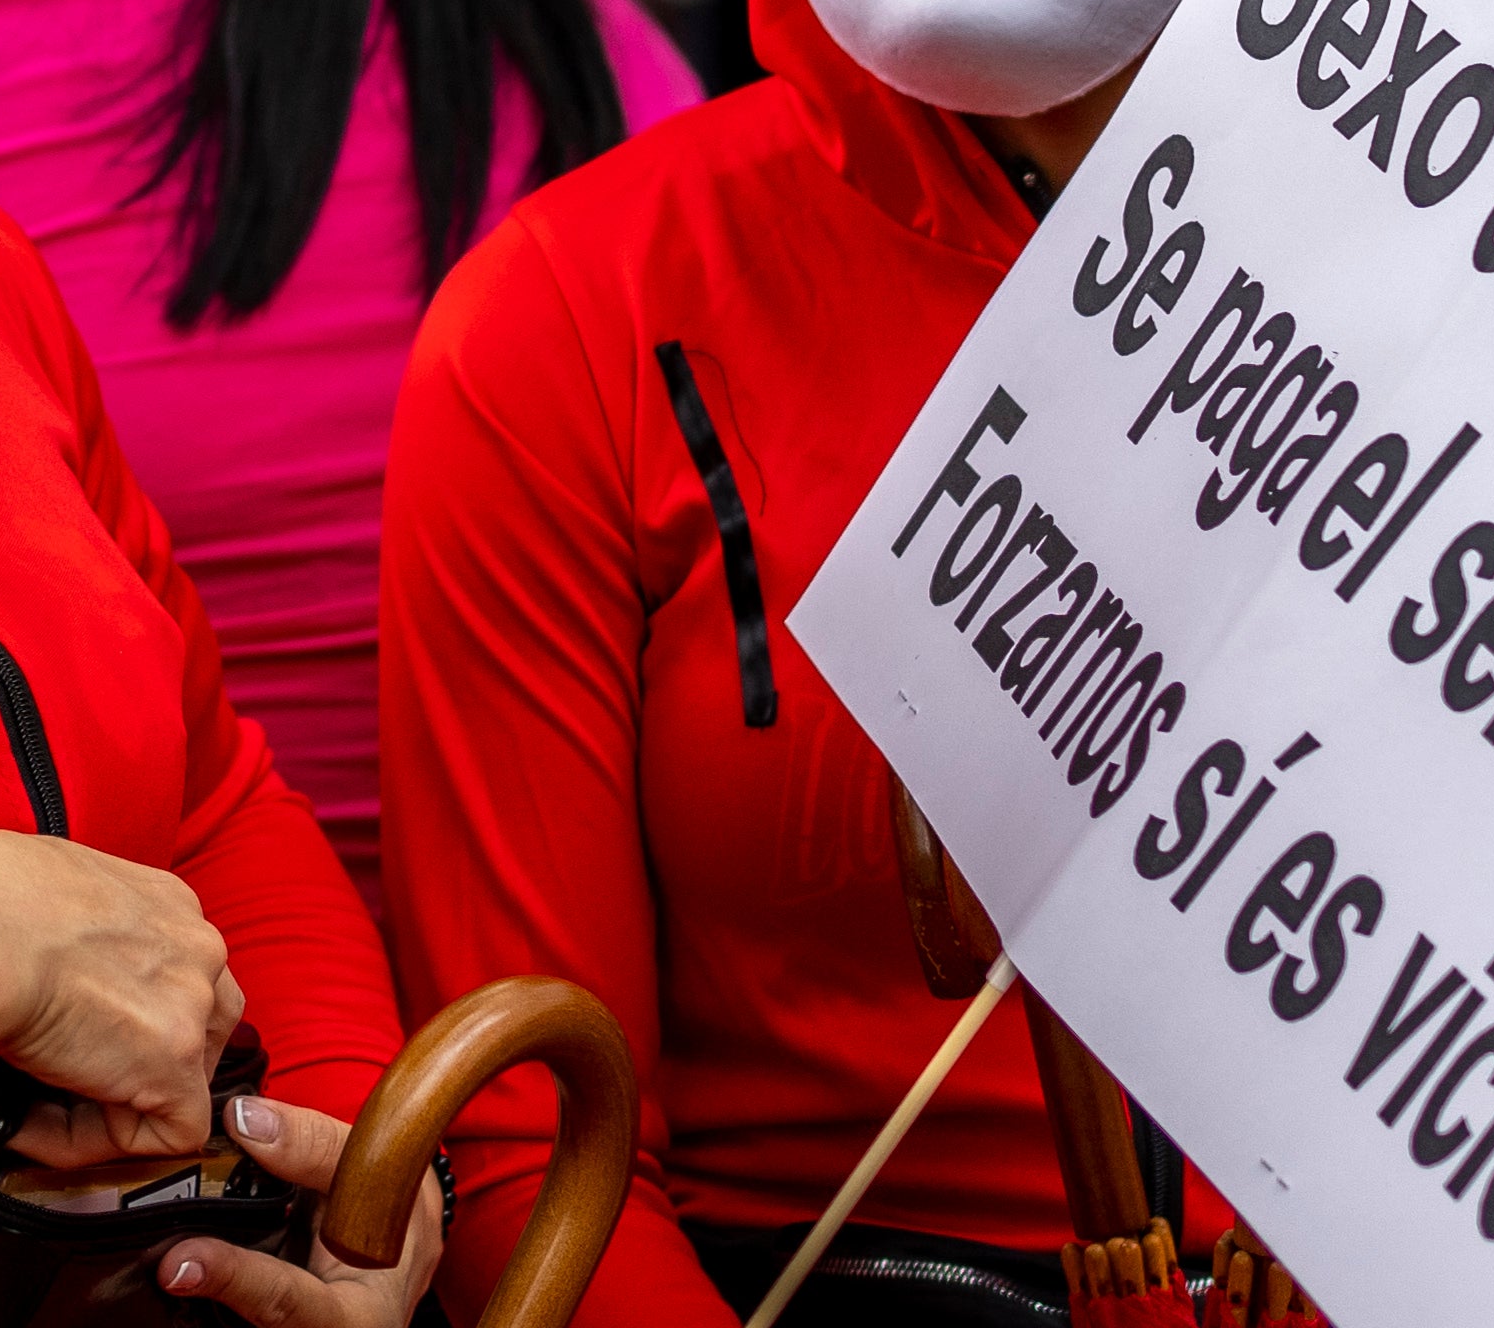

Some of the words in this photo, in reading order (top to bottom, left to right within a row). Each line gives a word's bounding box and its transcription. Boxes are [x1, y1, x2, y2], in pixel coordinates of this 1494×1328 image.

[1071, 133, 1207, 358] Se
[890, 383, 1187, 820] Forzarnos
[1133, 730, 1322, 914] sí
[1225, 831, 1385, 1023] es
